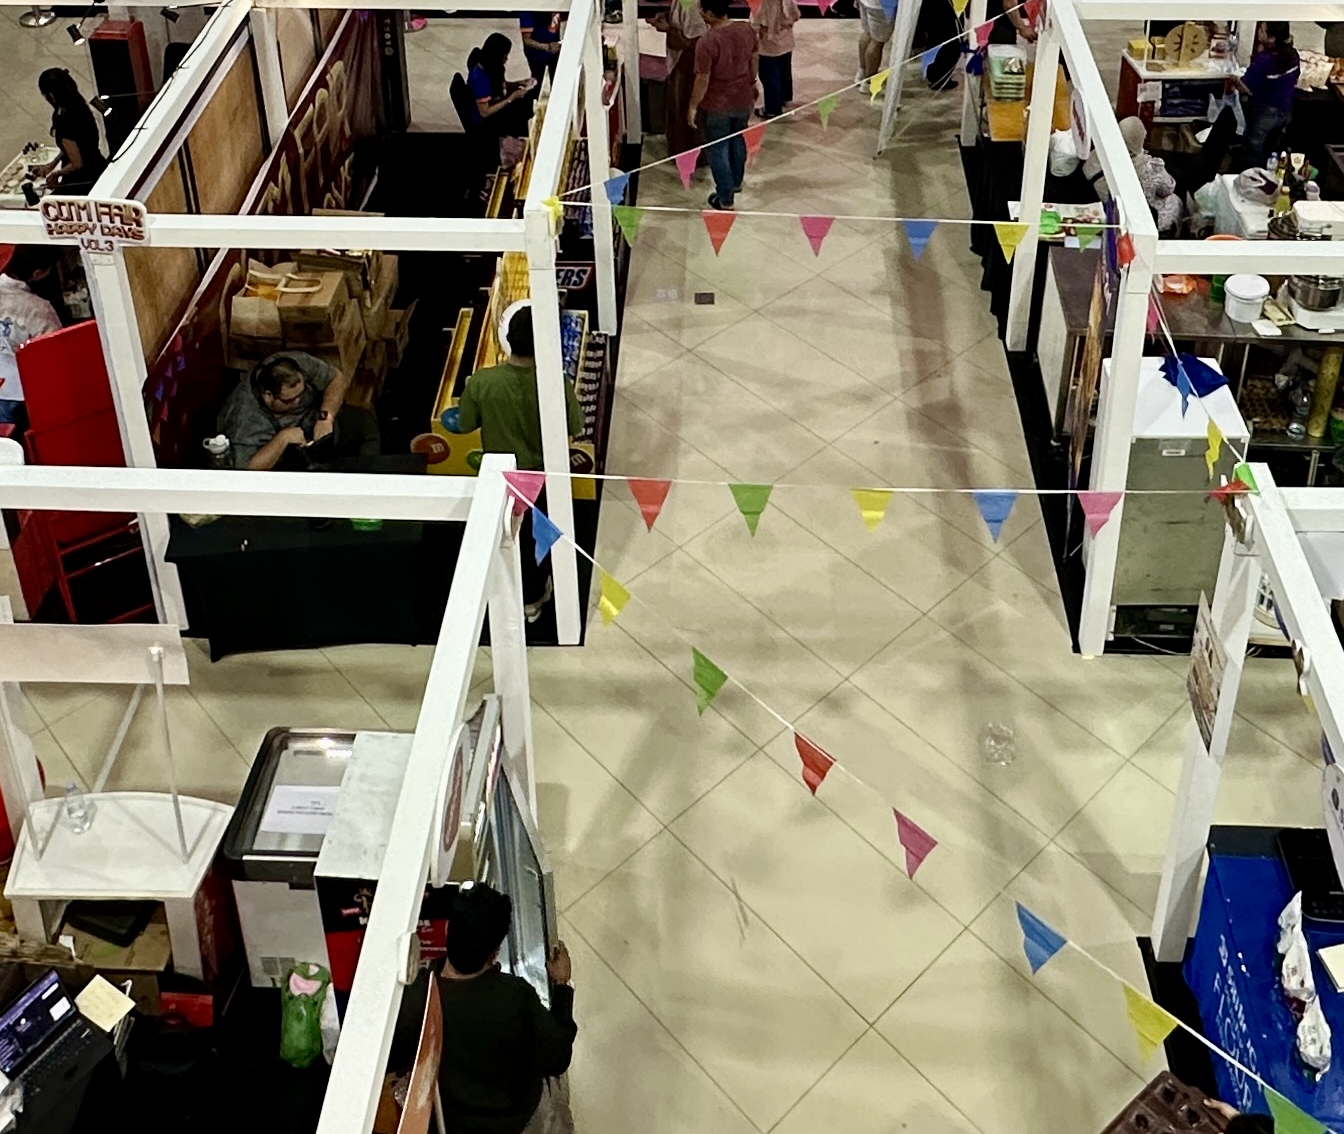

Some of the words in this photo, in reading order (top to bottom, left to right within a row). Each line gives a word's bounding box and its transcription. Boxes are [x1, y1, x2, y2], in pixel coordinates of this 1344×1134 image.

[42, 201, 93, 223] CLTM
[95, 201, 143, 228] FAIR
[47, 222, 97, 236] HAPPY
[100, 223, 145, 241] DAYS
